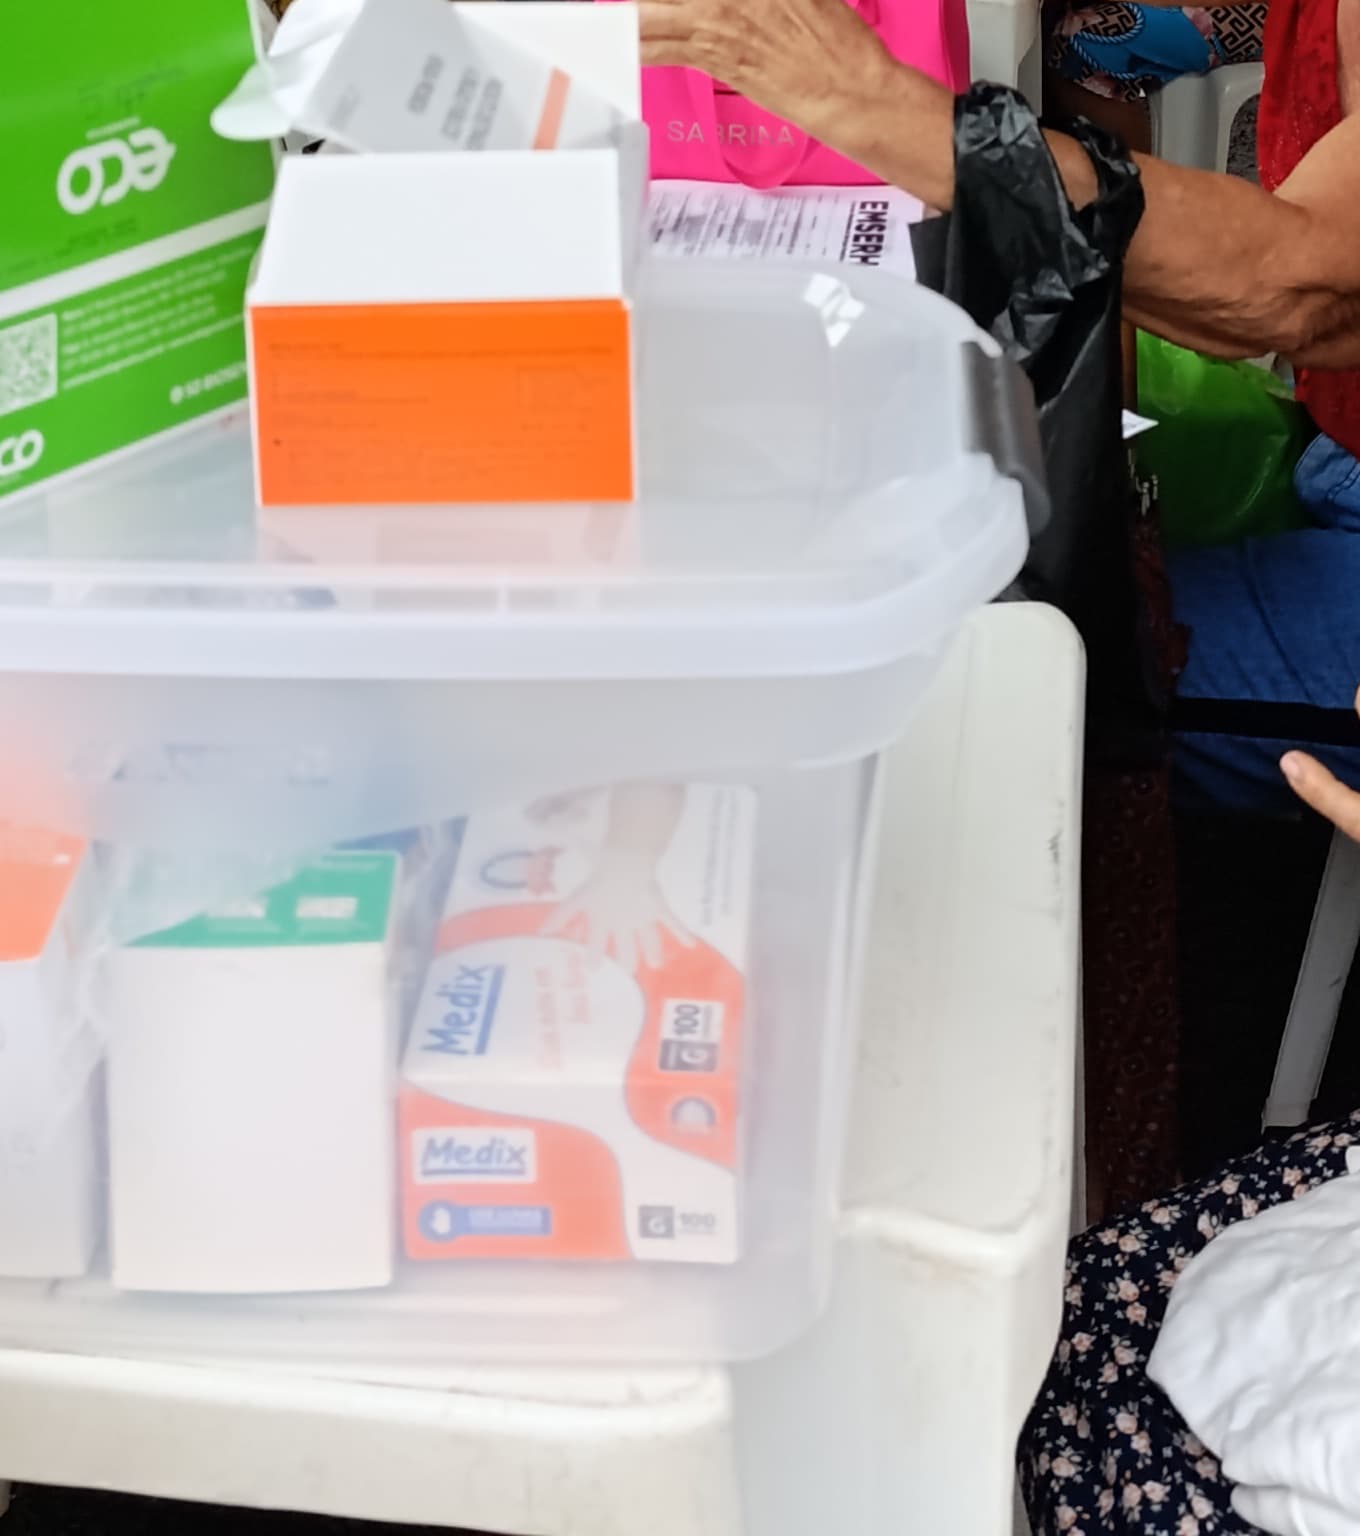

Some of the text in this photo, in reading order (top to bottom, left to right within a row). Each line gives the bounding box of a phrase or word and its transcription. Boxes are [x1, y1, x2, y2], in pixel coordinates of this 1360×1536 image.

[848, 199, 891, 267] EMSERH
[420, 963, 492, 1057] Medix
[672, 1003, 702, 1035] 100
[421, 1136, 528, 1169] Medix
[679, 1210, 717, 1229] 100
